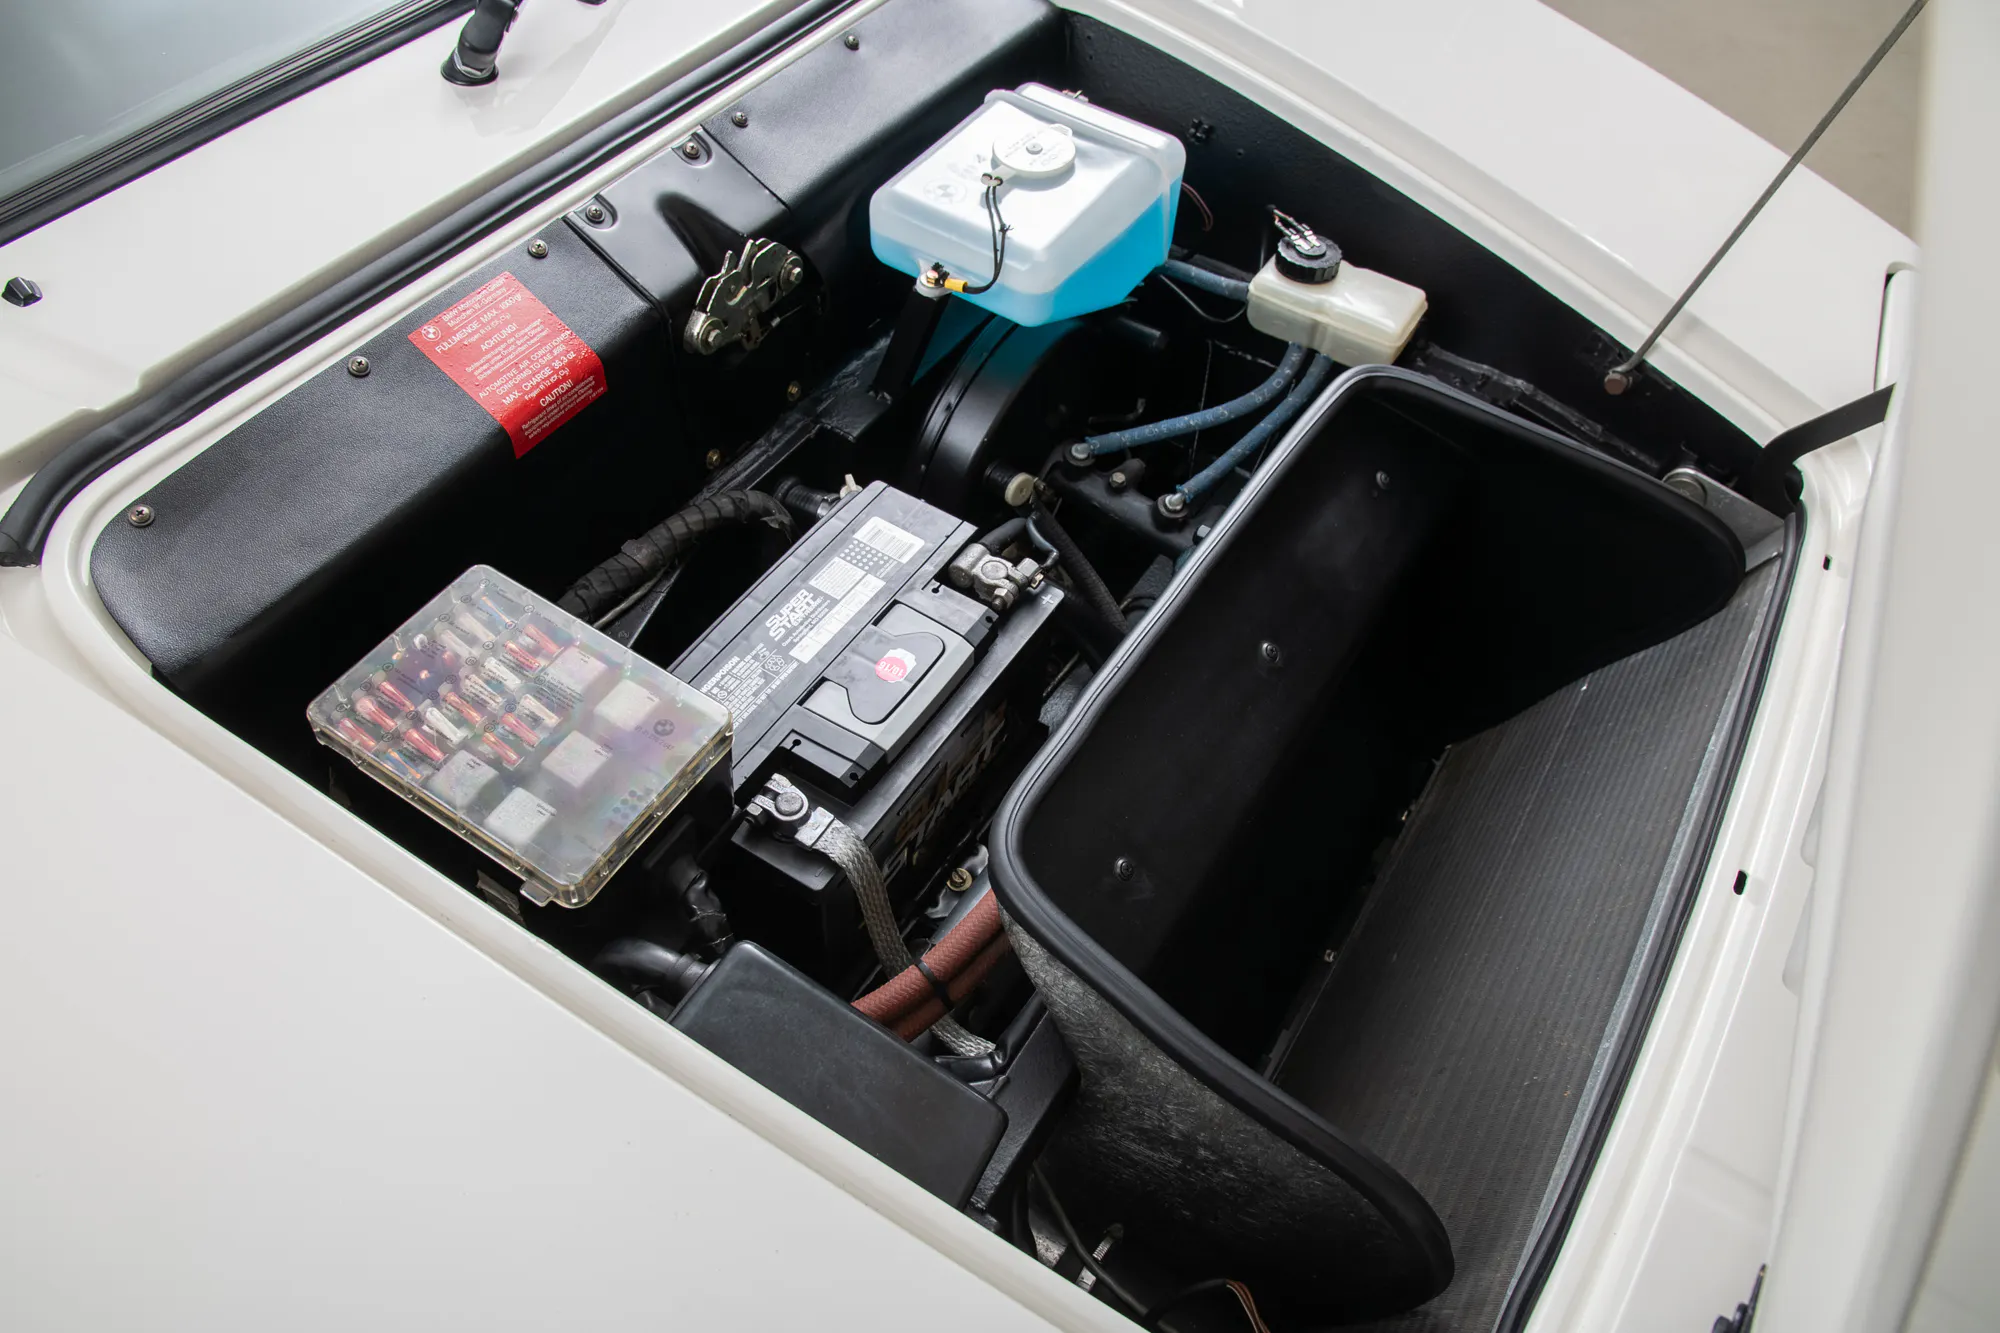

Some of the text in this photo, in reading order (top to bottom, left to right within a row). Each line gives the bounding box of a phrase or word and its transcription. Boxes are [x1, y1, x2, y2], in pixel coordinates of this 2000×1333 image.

[442, 308, 459, 321] BMW
[479, 307, 500, 323] MAX.
[478, 322, 518, 351] ACHTUNG!
[477, 367, 519, 398] AUTOMOTIVE
[517, 359, 531, 369] AIR
[495, 368, 532, 395] CONFORMS
[529, 362, 540, 371] TO
[538, 353, 553, 364] SAE
[501, 389, 522, 405] MAX.
[520, 366, 553, 391] CHARGE
[539, 378, 573, 407] CAUTION!
[764, 588, 810, 631] SUPER
[768, 592, 819, 642] START
[700, 654, 740, 693] NGER/POISON
[879, 661, 904, 676] 10/16
